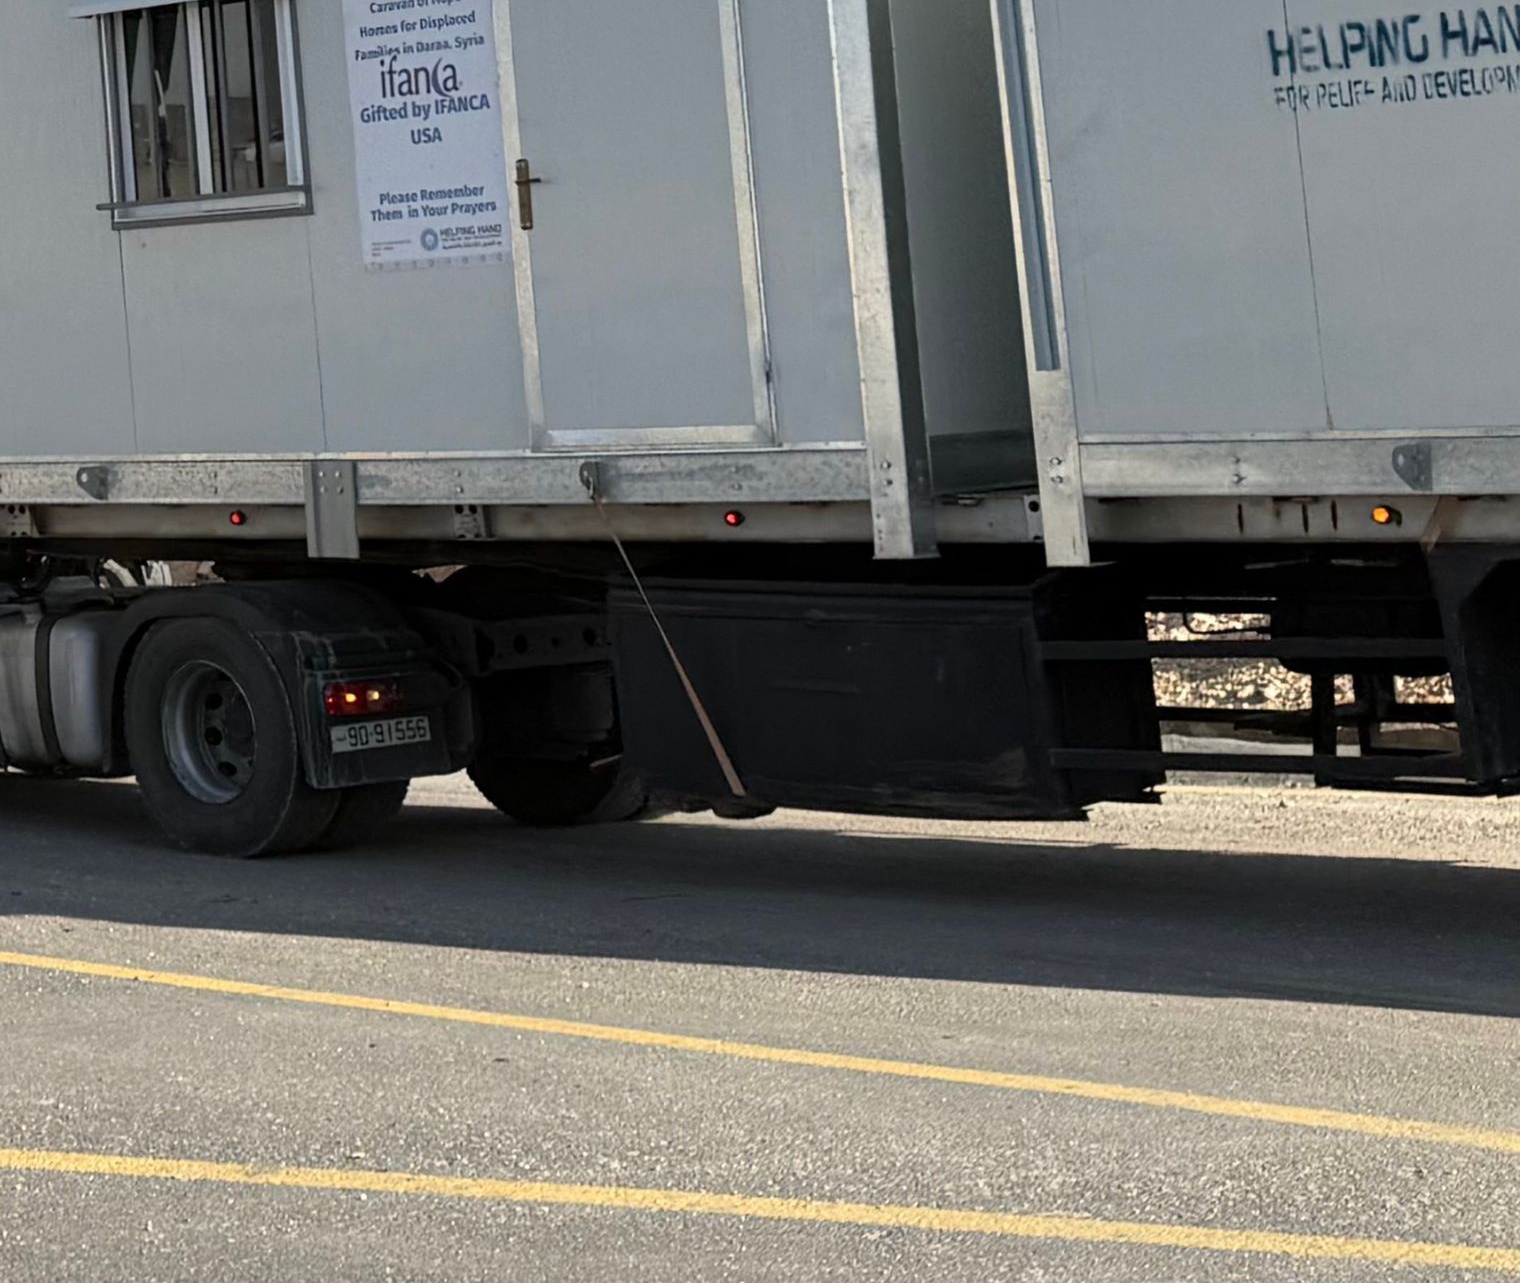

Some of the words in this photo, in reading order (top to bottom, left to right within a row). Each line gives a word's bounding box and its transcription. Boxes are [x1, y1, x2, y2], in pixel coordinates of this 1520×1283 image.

[359, 24, 399, 38] Homes
[400, 19, 417, 33] for
[419, 10, 476, 31] Displaced
[354, 44, 401, 61] Families
[402, 41, 415, 54] in
[454, 32, 486, 51] Syria
[1266, 14, 1429, 77] HELPING
[360, 101, 409, 123] Gifted
[411, 100, 432, 121] by
[434, 93, 491, 115] IFANCA
[1273, 84, 1310, 111] FOR
[410, 126, 443, 145] USA
[379, 191, 418, 205] Please
[419, 184, 485, 200] Remember
[370, 208, 403, 221] Them
[407, 205, 419, 218] in
[420, 204, 449, 217] Your
[450, 200, 497, 216] Prayers
